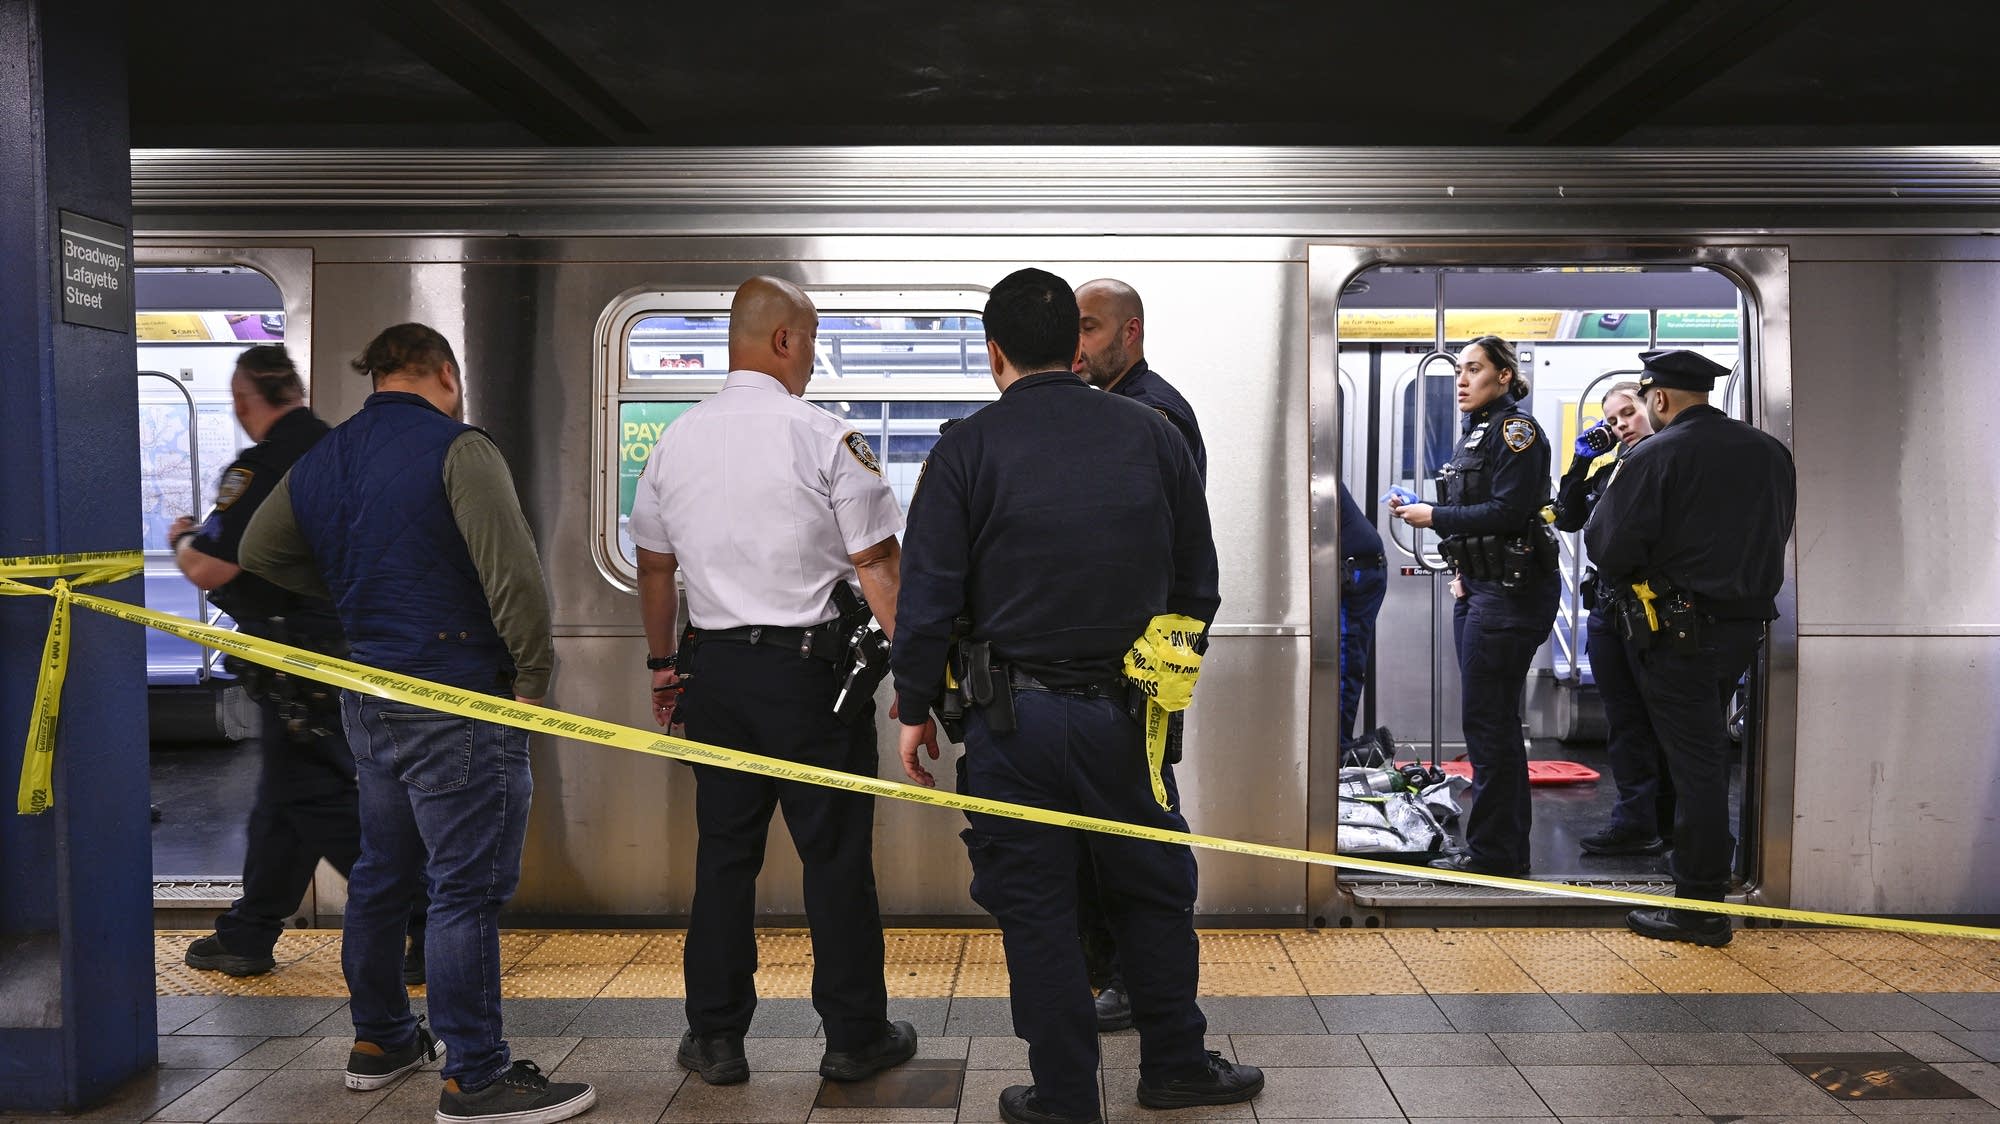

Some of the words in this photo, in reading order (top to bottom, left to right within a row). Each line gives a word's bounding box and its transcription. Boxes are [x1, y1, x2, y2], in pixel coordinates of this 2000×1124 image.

[64, 239, 125, 272] Broadway-
[65, 263, 118, 291] Lafayette
[66, 286, 103, 310] Street
[624, 422, 666, 442] PAY
[1170, 629, 1184, 648] DO
